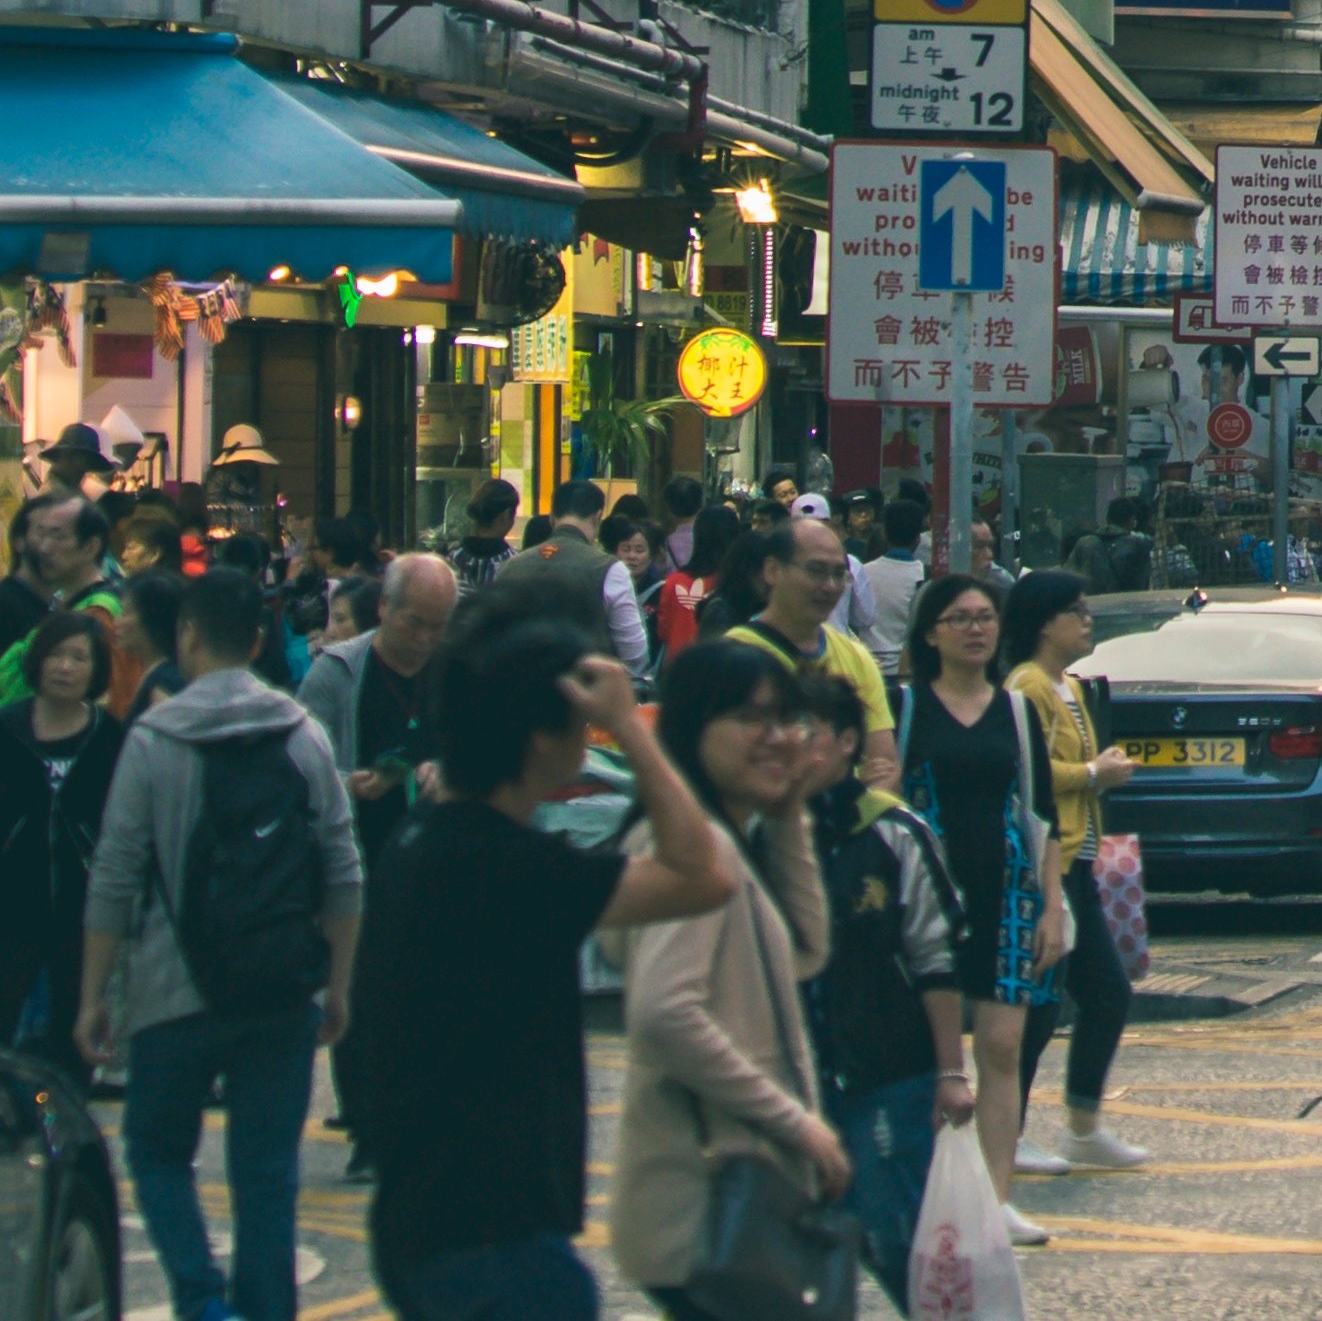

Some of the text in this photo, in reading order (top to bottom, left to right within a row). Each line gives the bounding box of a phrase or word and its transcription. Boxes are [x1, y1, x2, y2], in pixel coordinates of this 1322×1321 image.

[908, 29, 935, 41] am
[900, 45, 943, 66] 上午
[970, 34, 995, 67] 7
[879, 83, 960, 103] midnight
[898, 104, 940, 125] 午夜
[969, 92, 1014, 127] 12
[1260, 154, 1317, 170] Vehicle
[856, 183, 917, 202] waiti
[1231, 173, 1290, 191] waiting
[1295, 175, 1322, 189] will
[1223, 211, 1284, 226] without
[842, 238, 918, 258] witho
[874, 314, 1014, 348] 會被控
[697, 356, 749, 378] 椰汁
[699, 379, 745, 400] 大王
[1125, 740, 1235, 763] PP 3312
